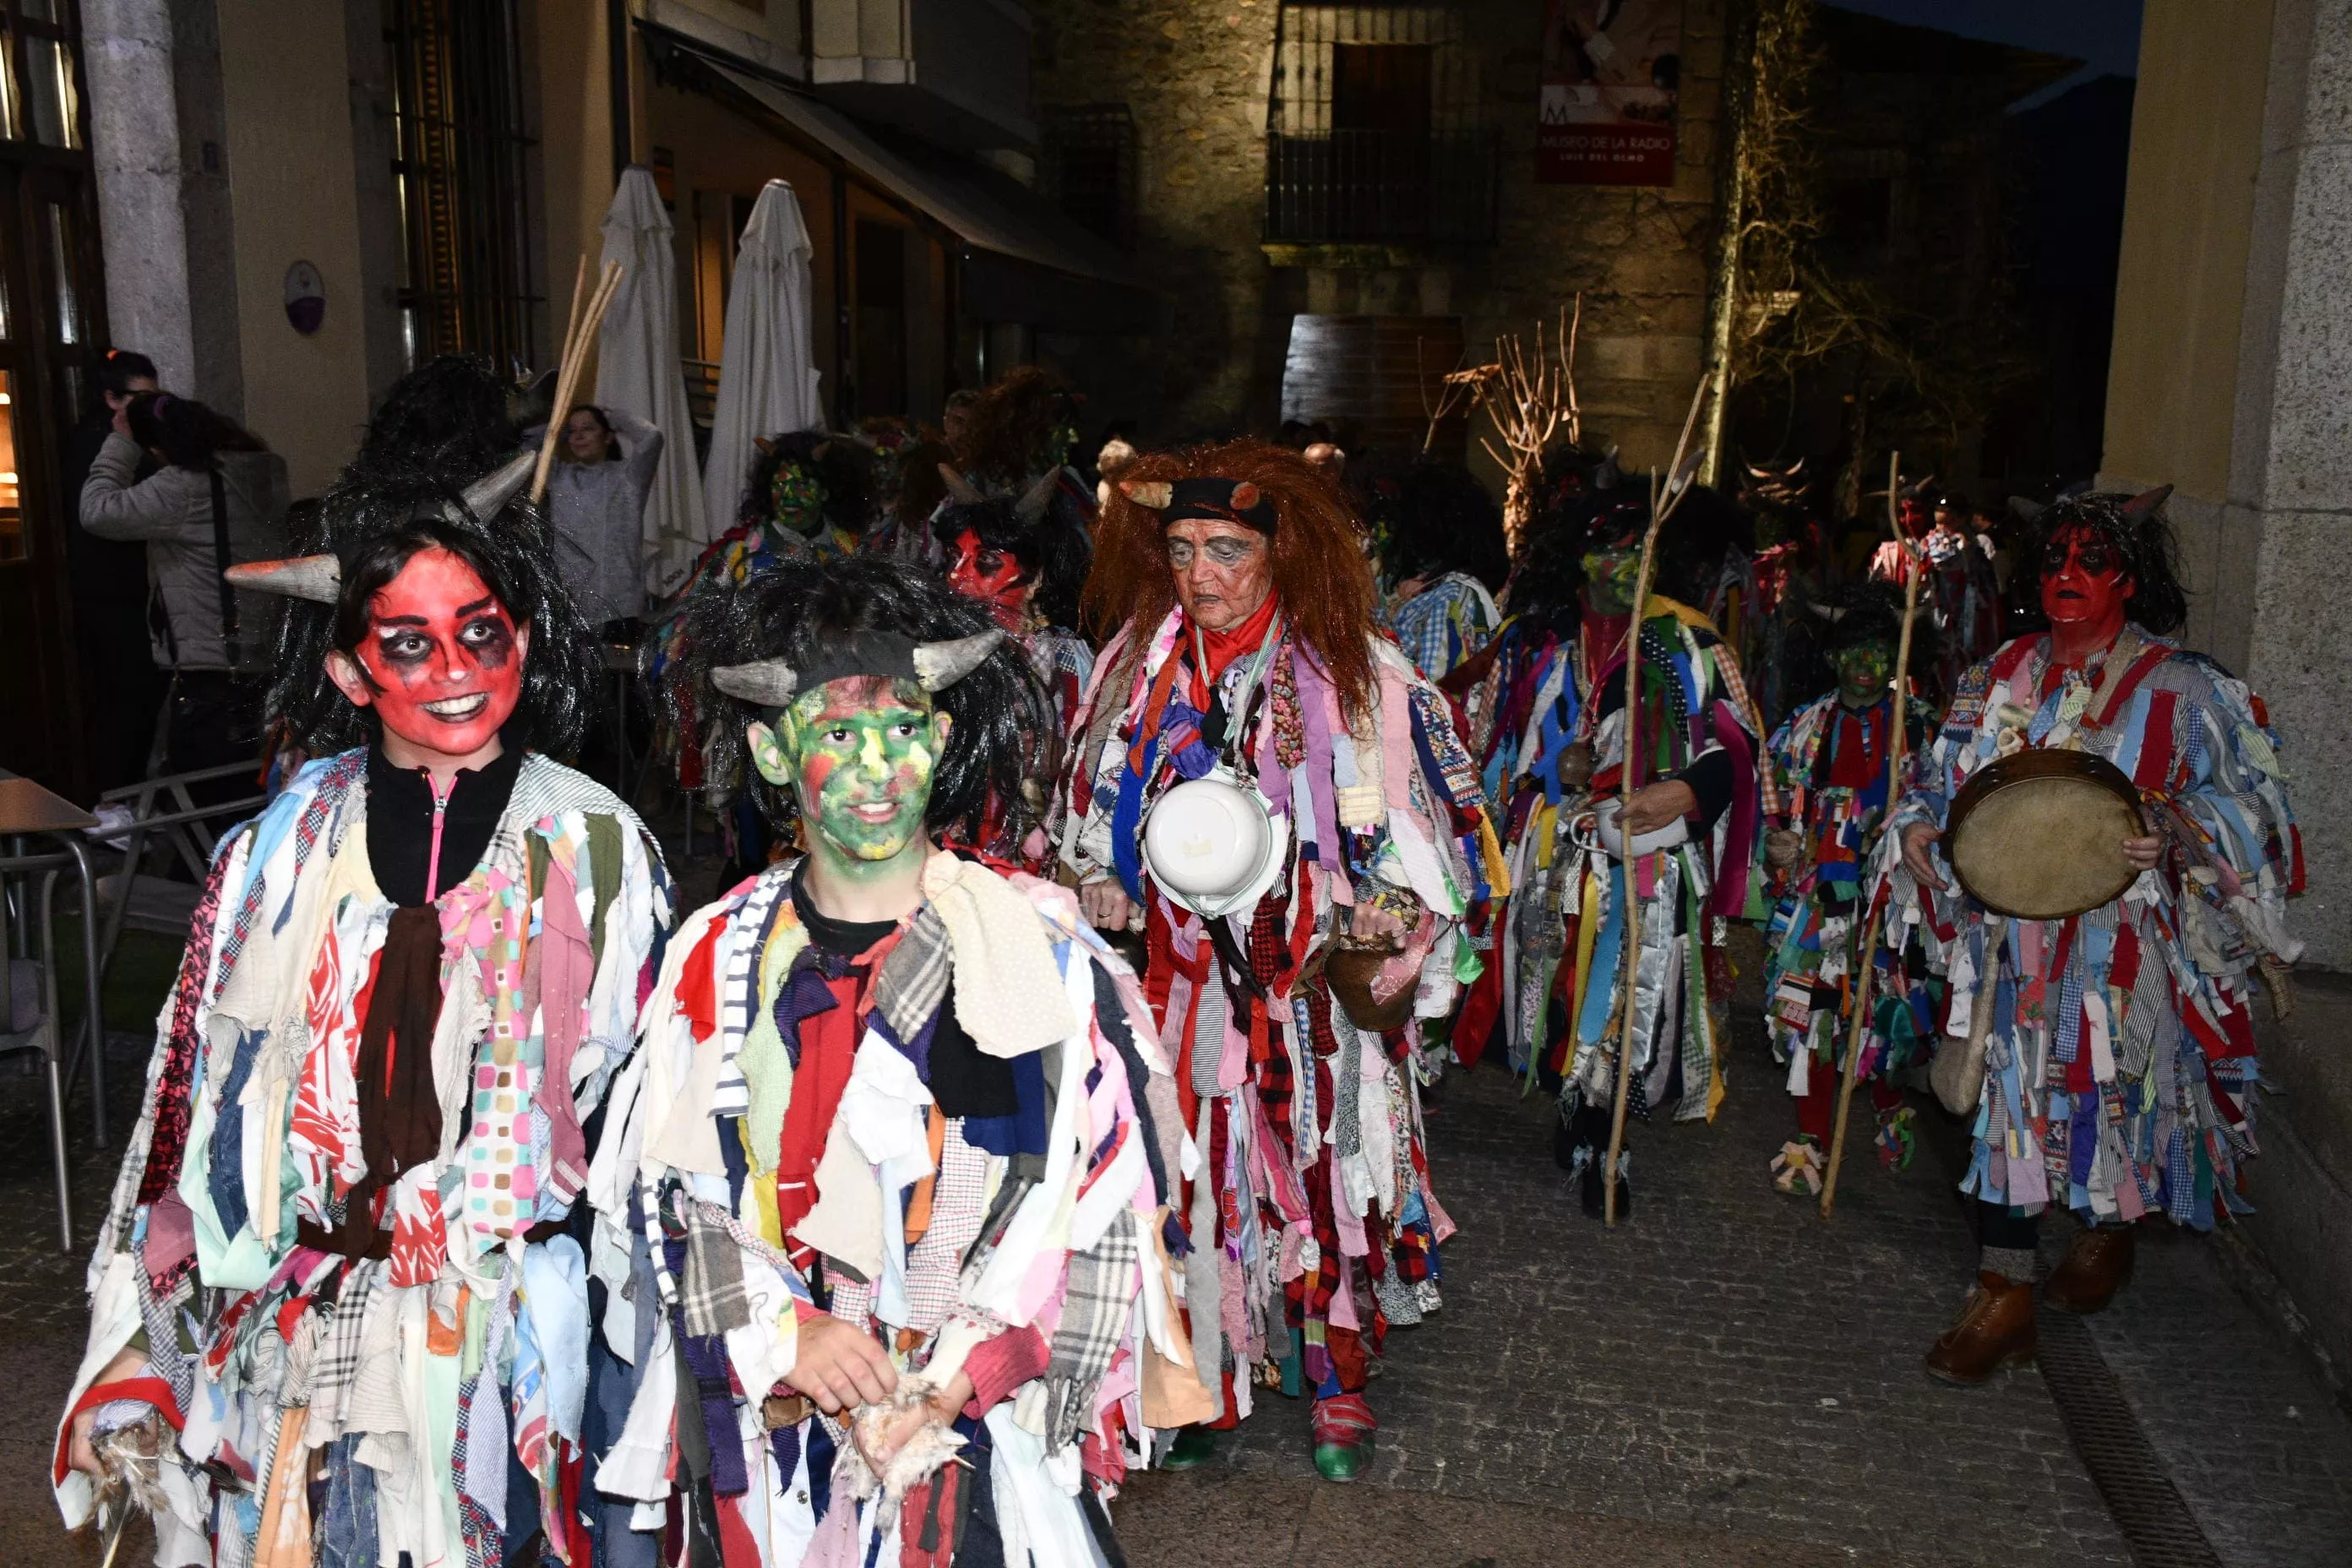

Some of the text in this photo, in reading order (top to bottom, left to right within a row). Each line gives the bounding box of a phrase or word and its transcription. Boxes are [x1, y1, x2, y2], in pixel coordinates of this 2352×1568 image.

[1541, 135, 1671, 151] MUSEO DE LA RADIO
[1560, 153, 1646, 163] LUIS DEL OLMO
